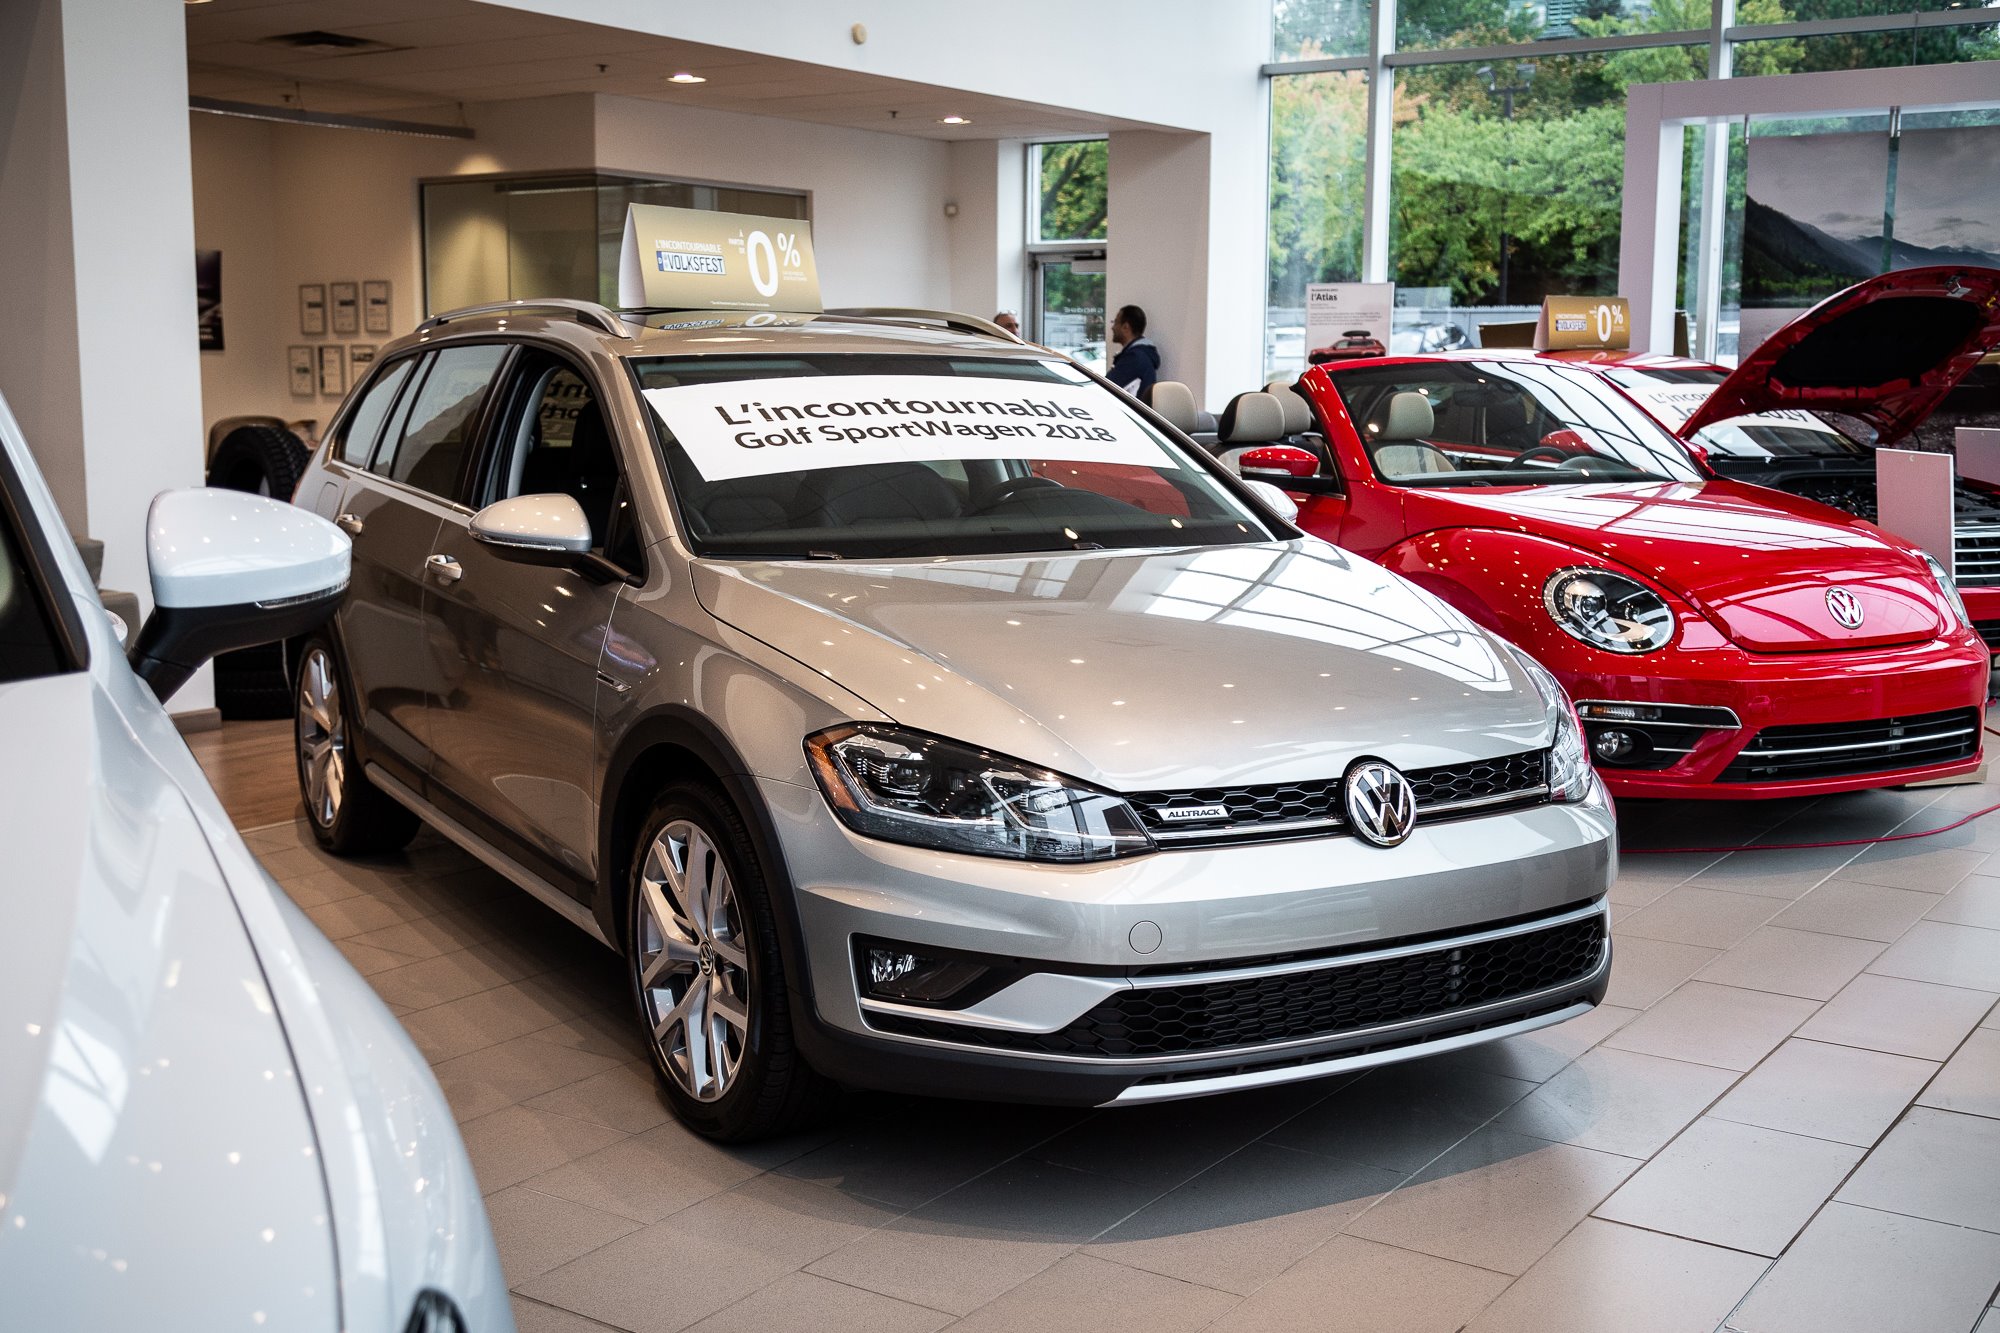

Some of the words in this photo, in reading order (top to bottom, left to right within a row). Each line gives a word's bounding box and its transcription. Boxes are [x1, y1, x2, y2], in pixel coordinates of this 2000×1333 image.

[667, 254, 723, 273] VOLKSFEST
[714, 398, 1094, 426] L'incontournable
[734, 426, 813, 449] Golf
[818, 420, 1036, 444] SportWagen
[1036, 423, 1117, 442] 2018
[1168, 809, 1220, 818] ALLTRACK
